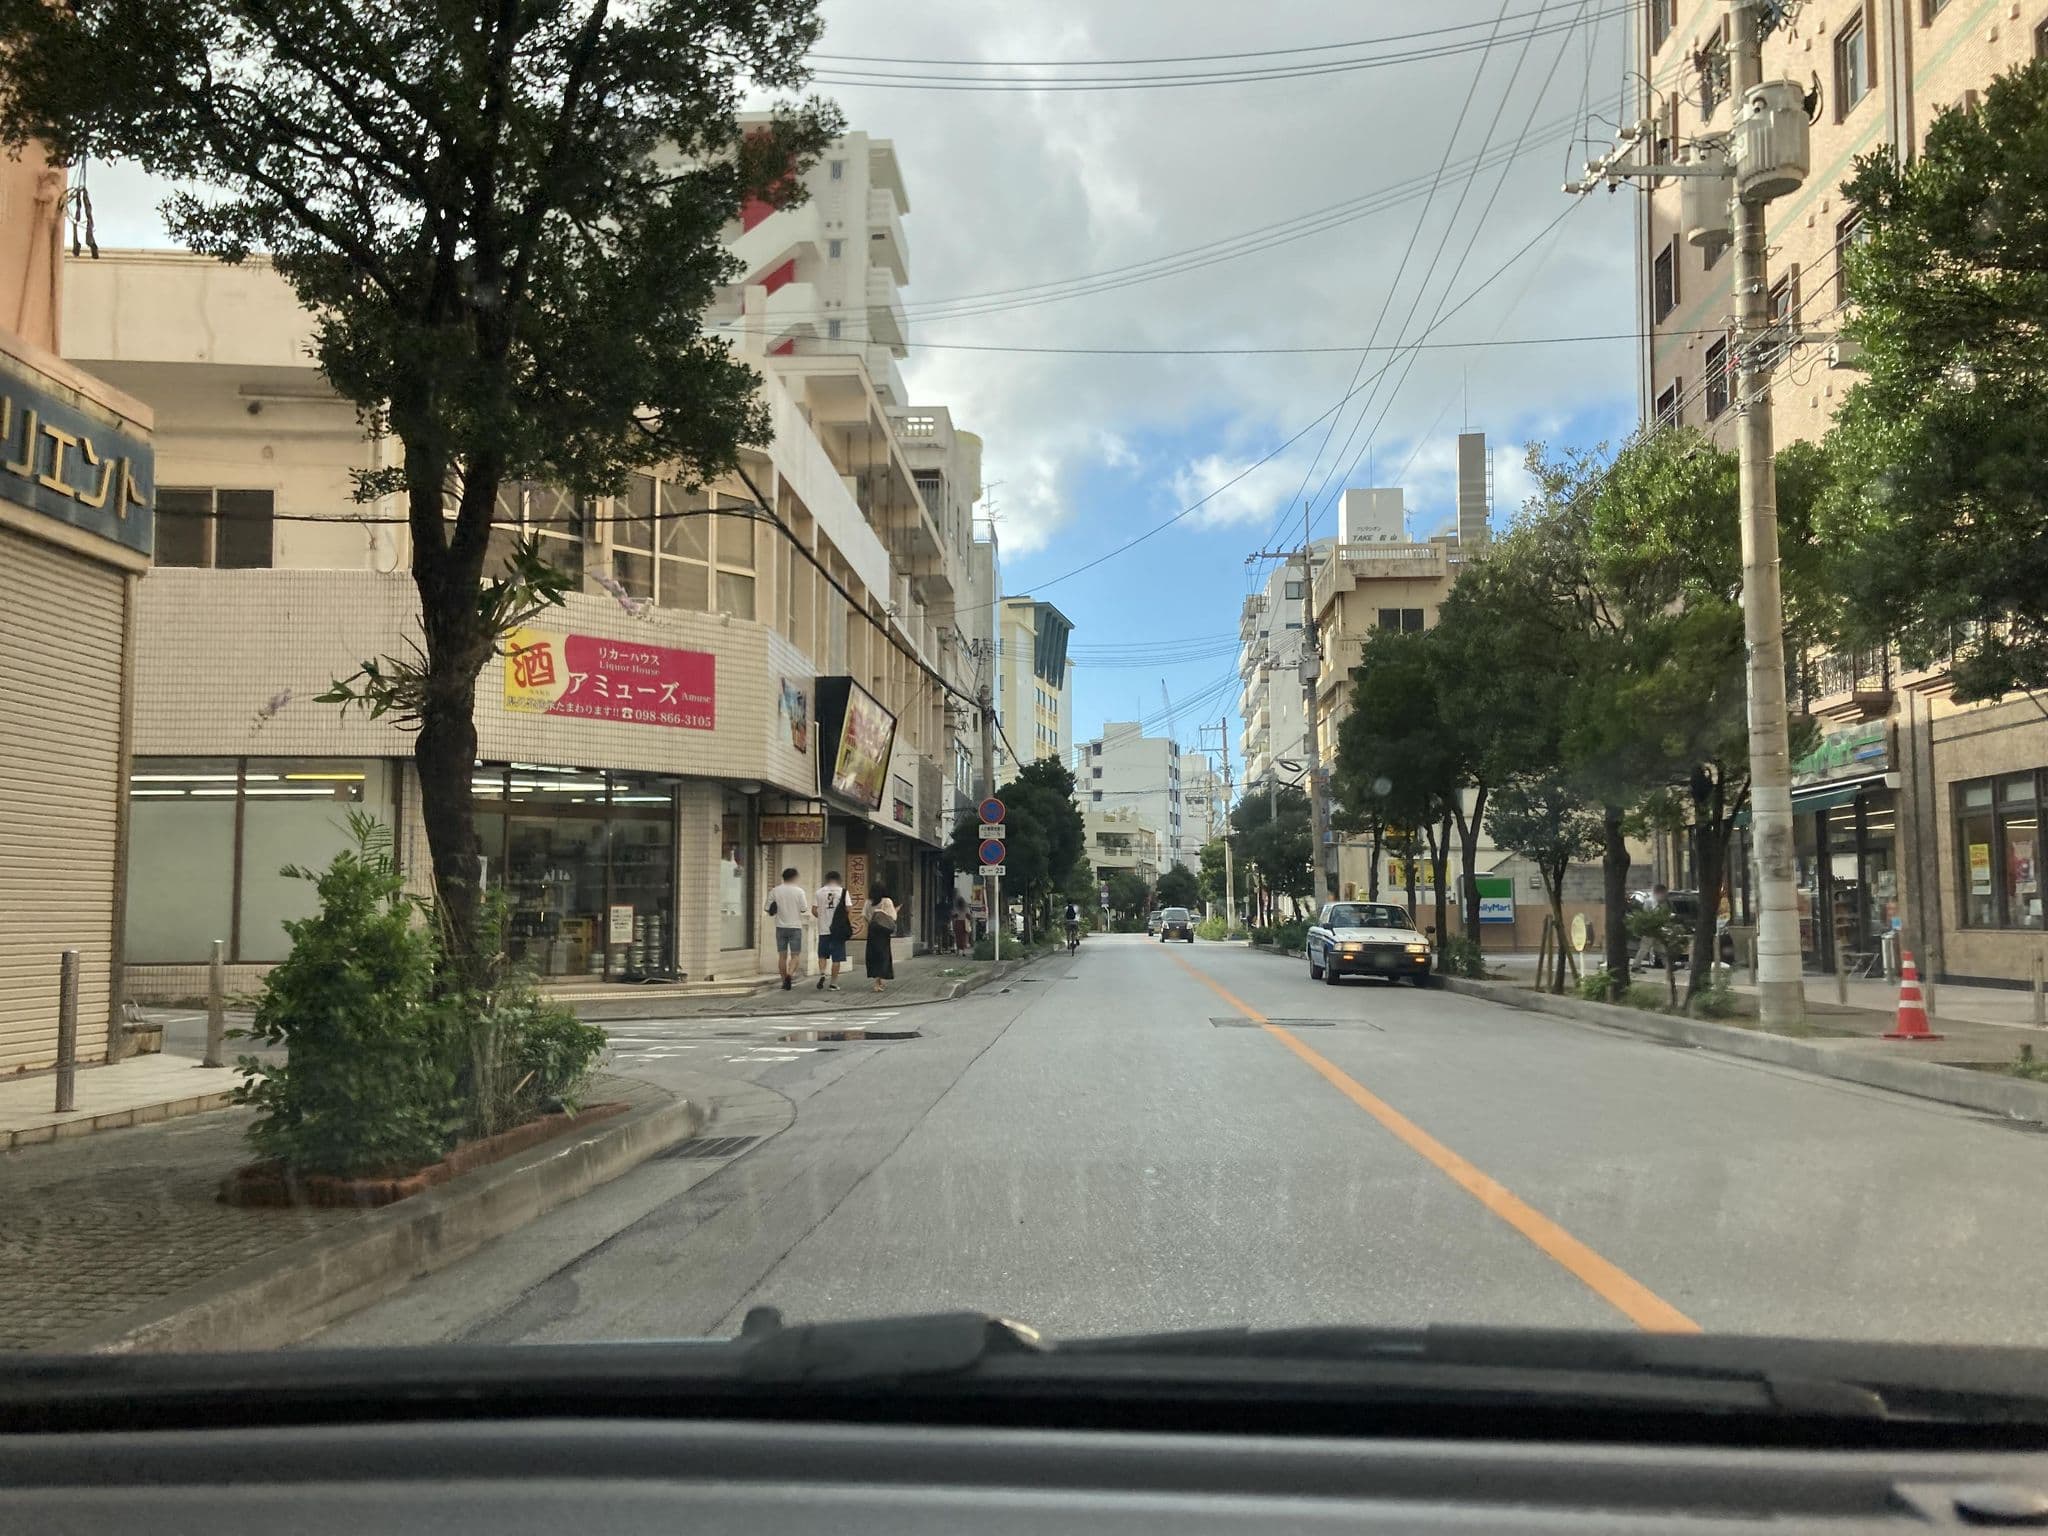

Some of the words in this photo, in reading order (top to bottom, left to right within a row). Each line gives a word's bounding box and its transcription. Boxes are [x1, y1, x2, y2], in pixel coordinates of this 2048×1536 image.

[511, 642, 556, 689] 酒
[599, 648, 660, 666] リカーハウス
[600, 661, 630, 672] Liquor
[632, 665, 660, 676] House
[569, 671, 680, 705] アミューズ
[682, 692, 712, 704] Amuse
[635, 709, 712, 728] 098-866-3105
[1480, 903, 1511, 912] ilyMart
